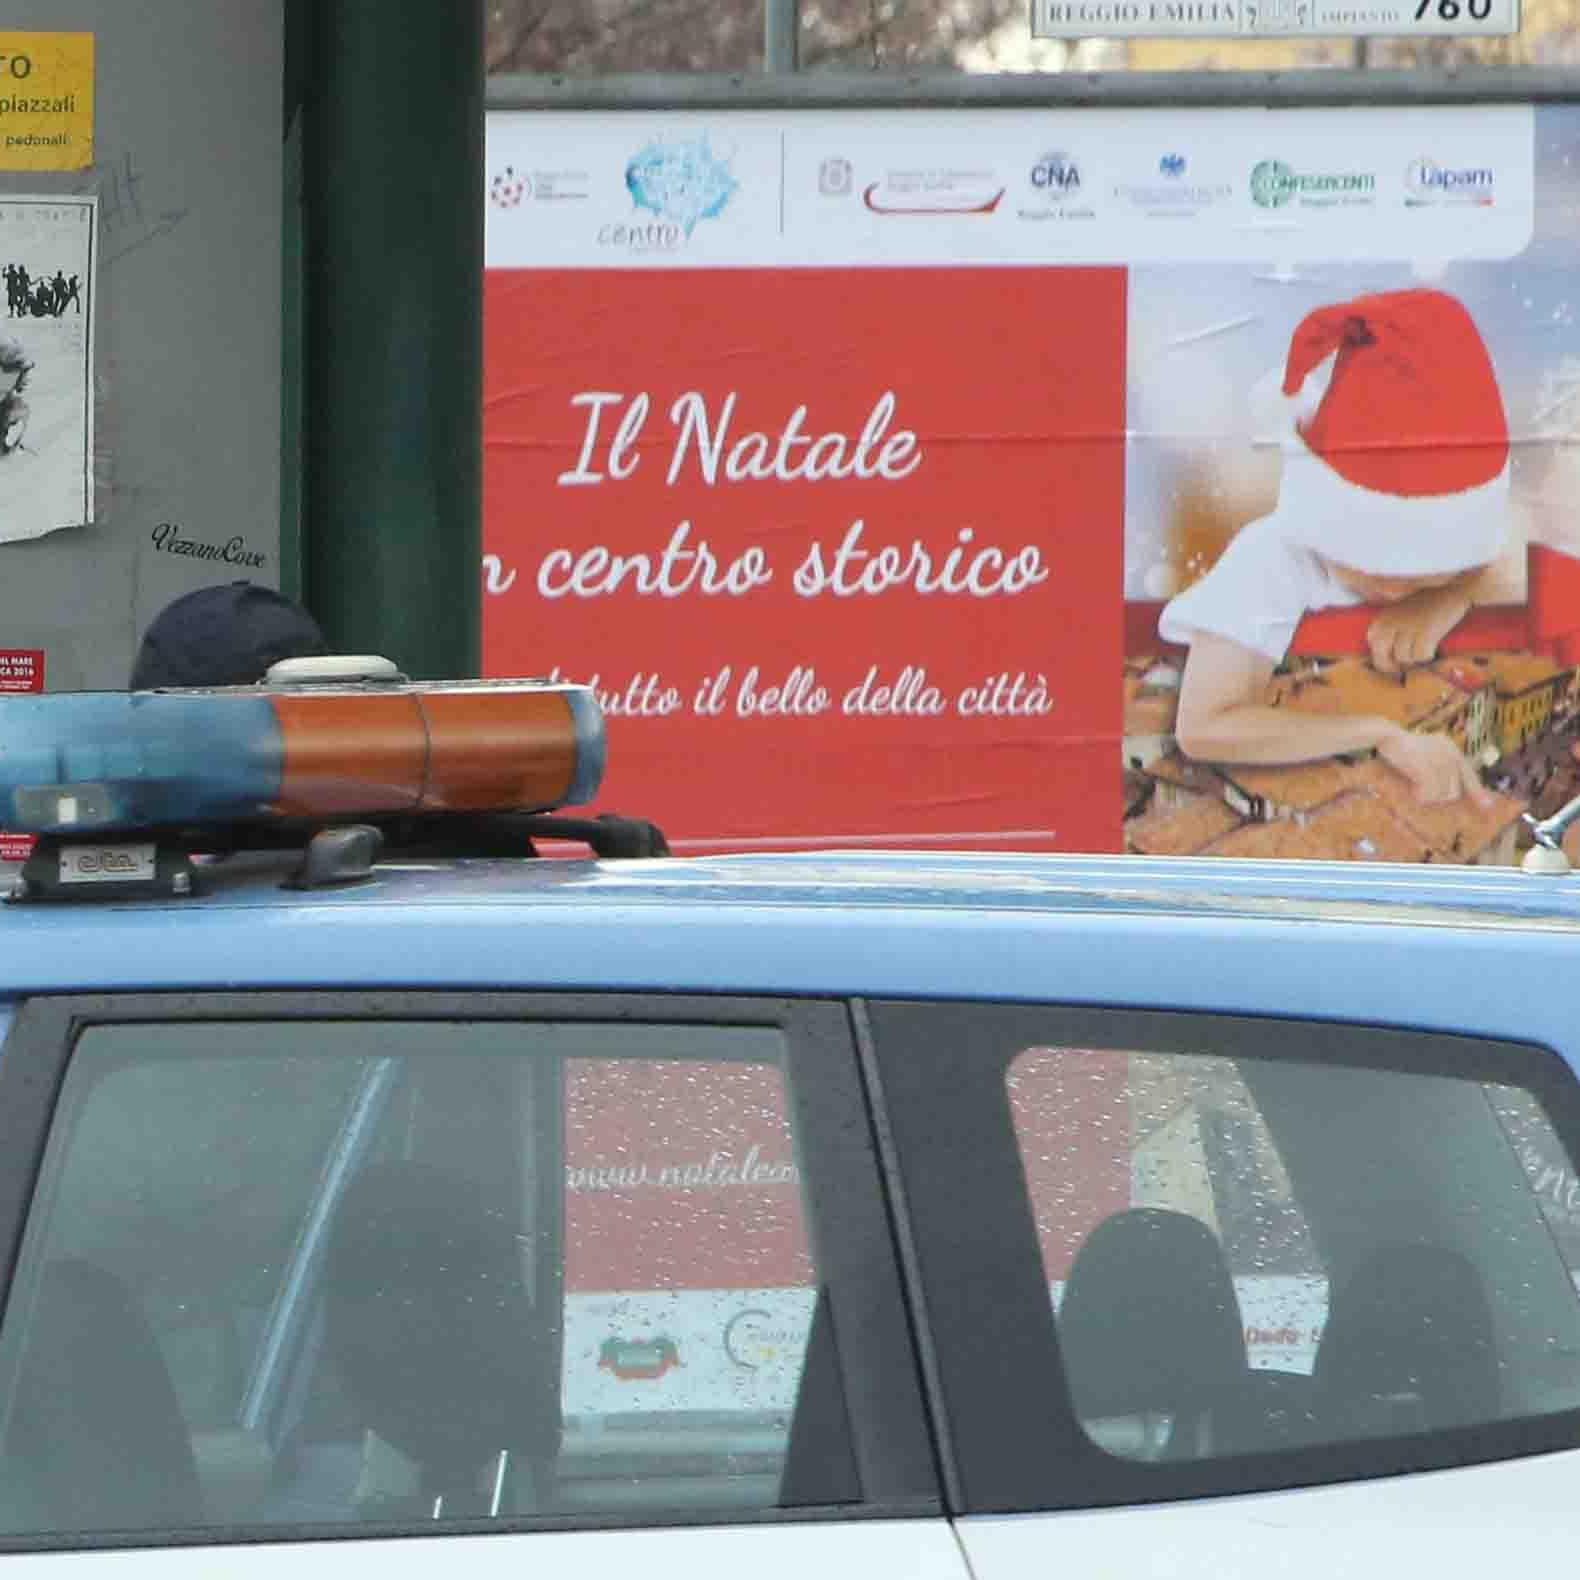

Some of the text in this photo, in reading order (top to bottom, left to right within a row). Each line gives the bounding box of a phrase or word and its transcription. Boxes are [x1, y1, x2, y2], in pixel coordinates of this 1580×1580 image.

[1049, 3, 1235, 22] REGGIO EMILIA
[6, 132, 68, 146] pedonali
[1030, 162, 1081, 190] CNA
[597, 222, 680, 250] centro
[557, 388, 924, 487] Il Natale
[536, 519, 773, 599] centro
[792, 518, 1050, 598] storico
[592, 664, 1054, 718] tutto il bello della città
